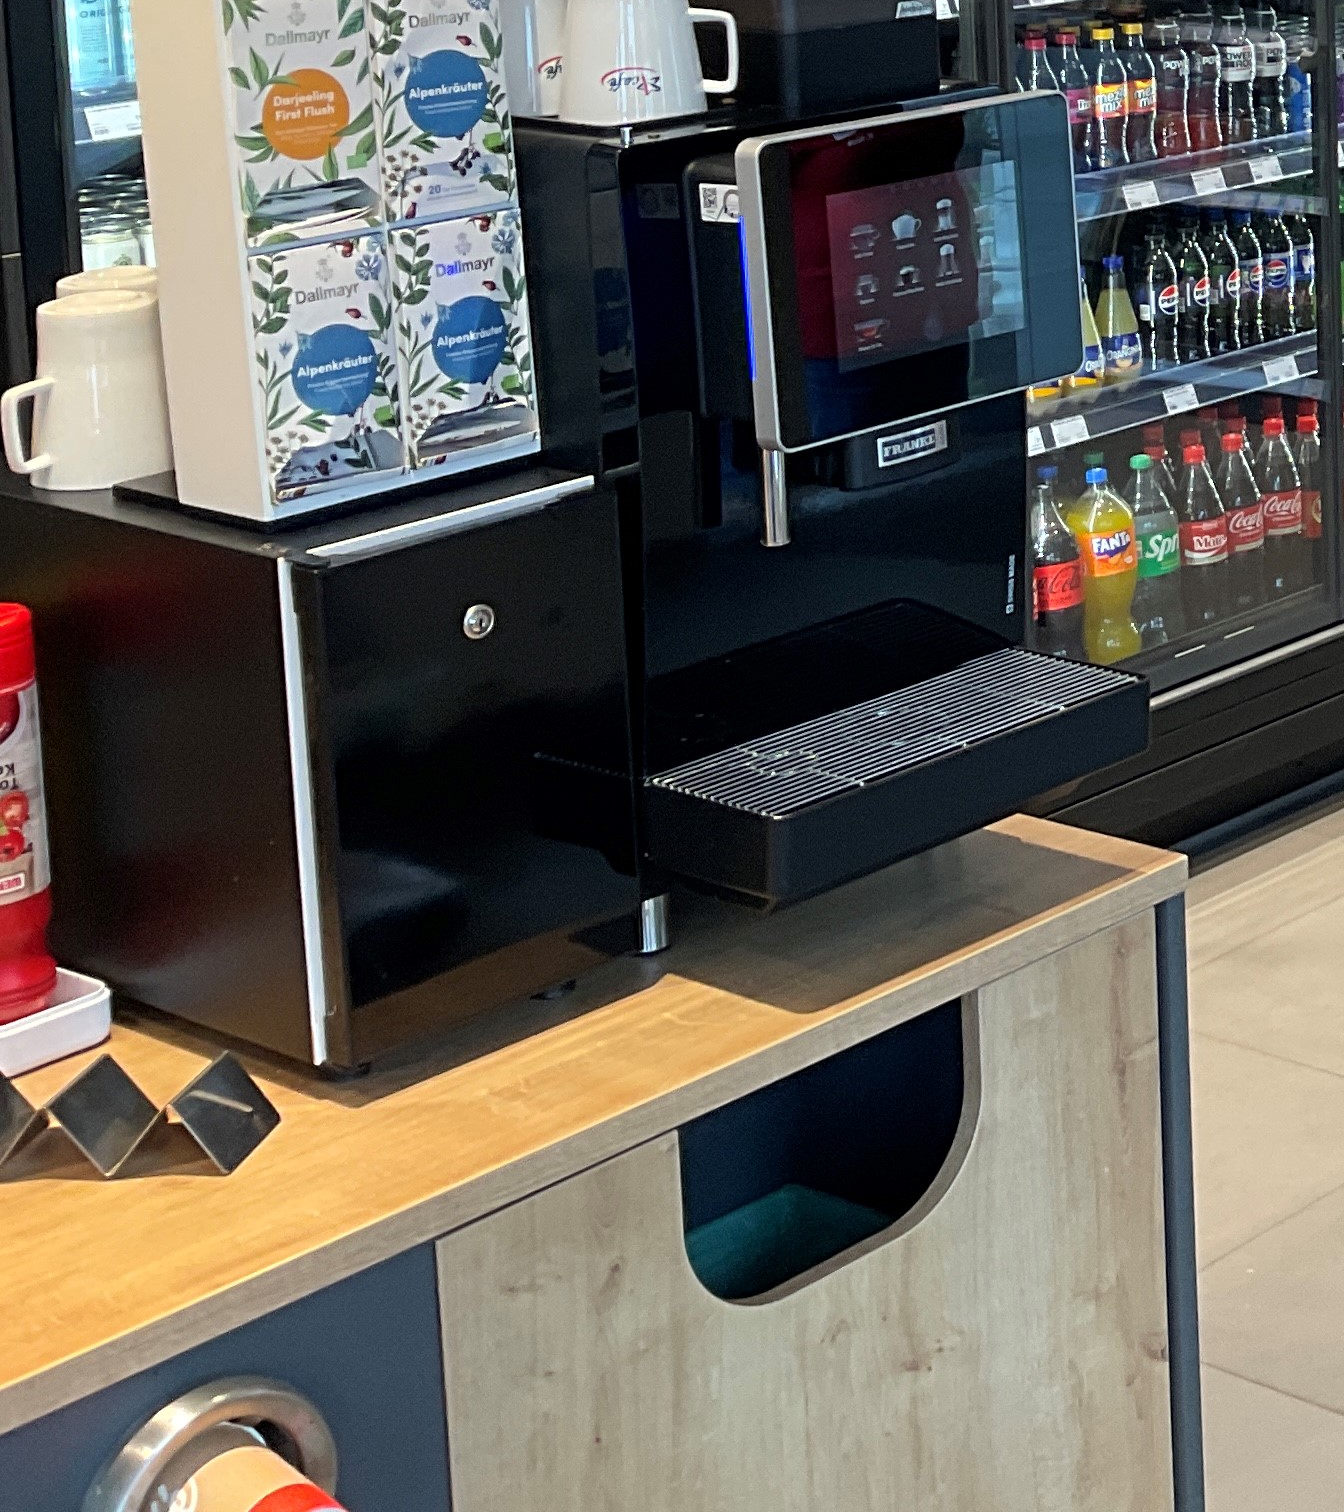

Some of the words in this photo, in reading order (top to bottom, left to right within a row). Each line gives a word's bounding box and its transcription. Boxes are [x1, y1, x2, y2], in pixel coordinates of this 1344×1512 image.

[408, 7, 471, 30] Dallmayr
[264, 28, 331, 48] Dallmayr
[272, 89, 335, 109] Darjeeling
[409, 80, 484, 101] Alpenkräuter
[274, 105, 302, 121] First
[304, 102, 336, 119] Flush
[1101, 99, 1123, 112] mix
[434, 255, 496, 279] Dallmayr
[294, 281, 360, 305] Dallmayr
[436, 324, 503, 349] Alpenkräuter
[297, 352, 374, 378] Alpenkräuter
[883, 434, 937, 465] FRANKE
[1092, 531, 1131, 554] FANTA
